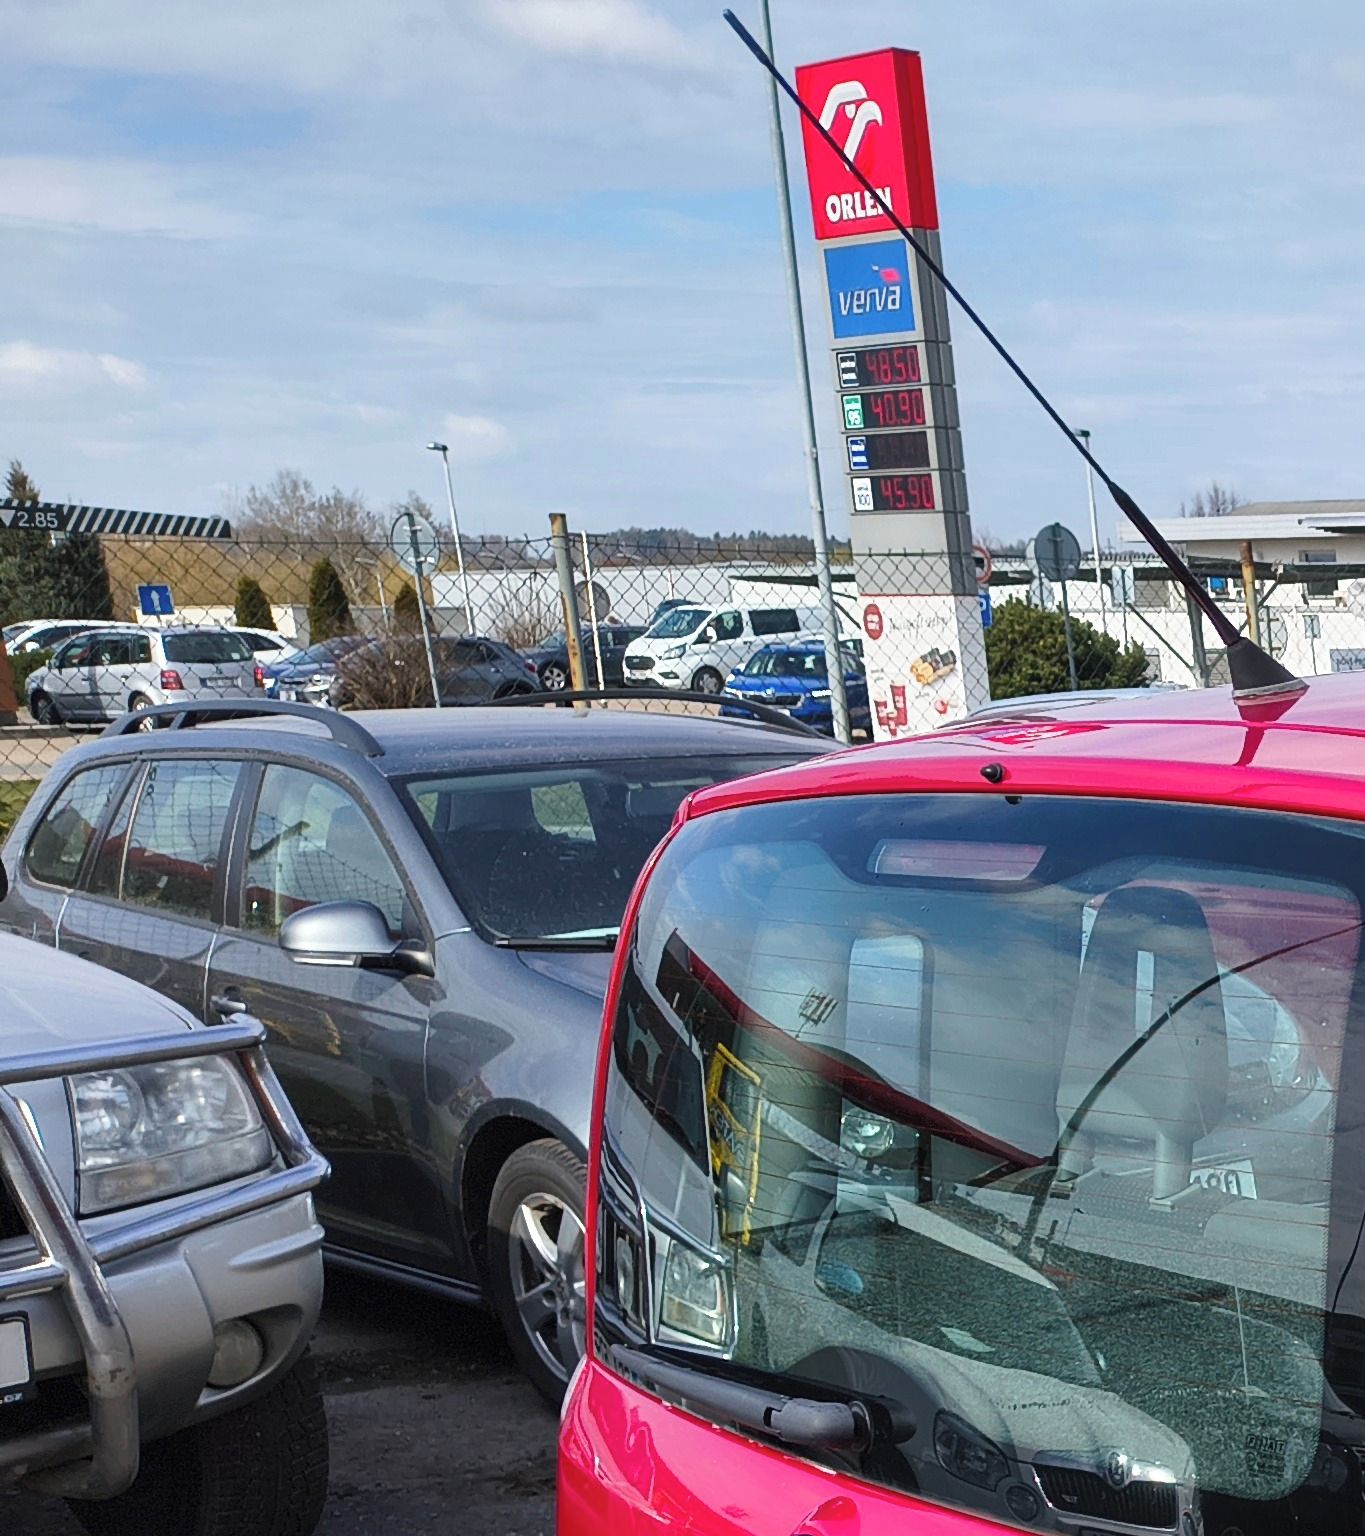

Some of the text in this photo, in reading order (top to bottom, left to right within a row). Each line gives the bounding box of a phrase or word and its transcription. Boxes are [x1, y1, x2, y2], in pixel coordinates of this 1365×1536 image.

[825, 187, 893, 223] ORLEN
[839, 285, 900, 315] verva
[17, 511, 58, 528] 2.85
